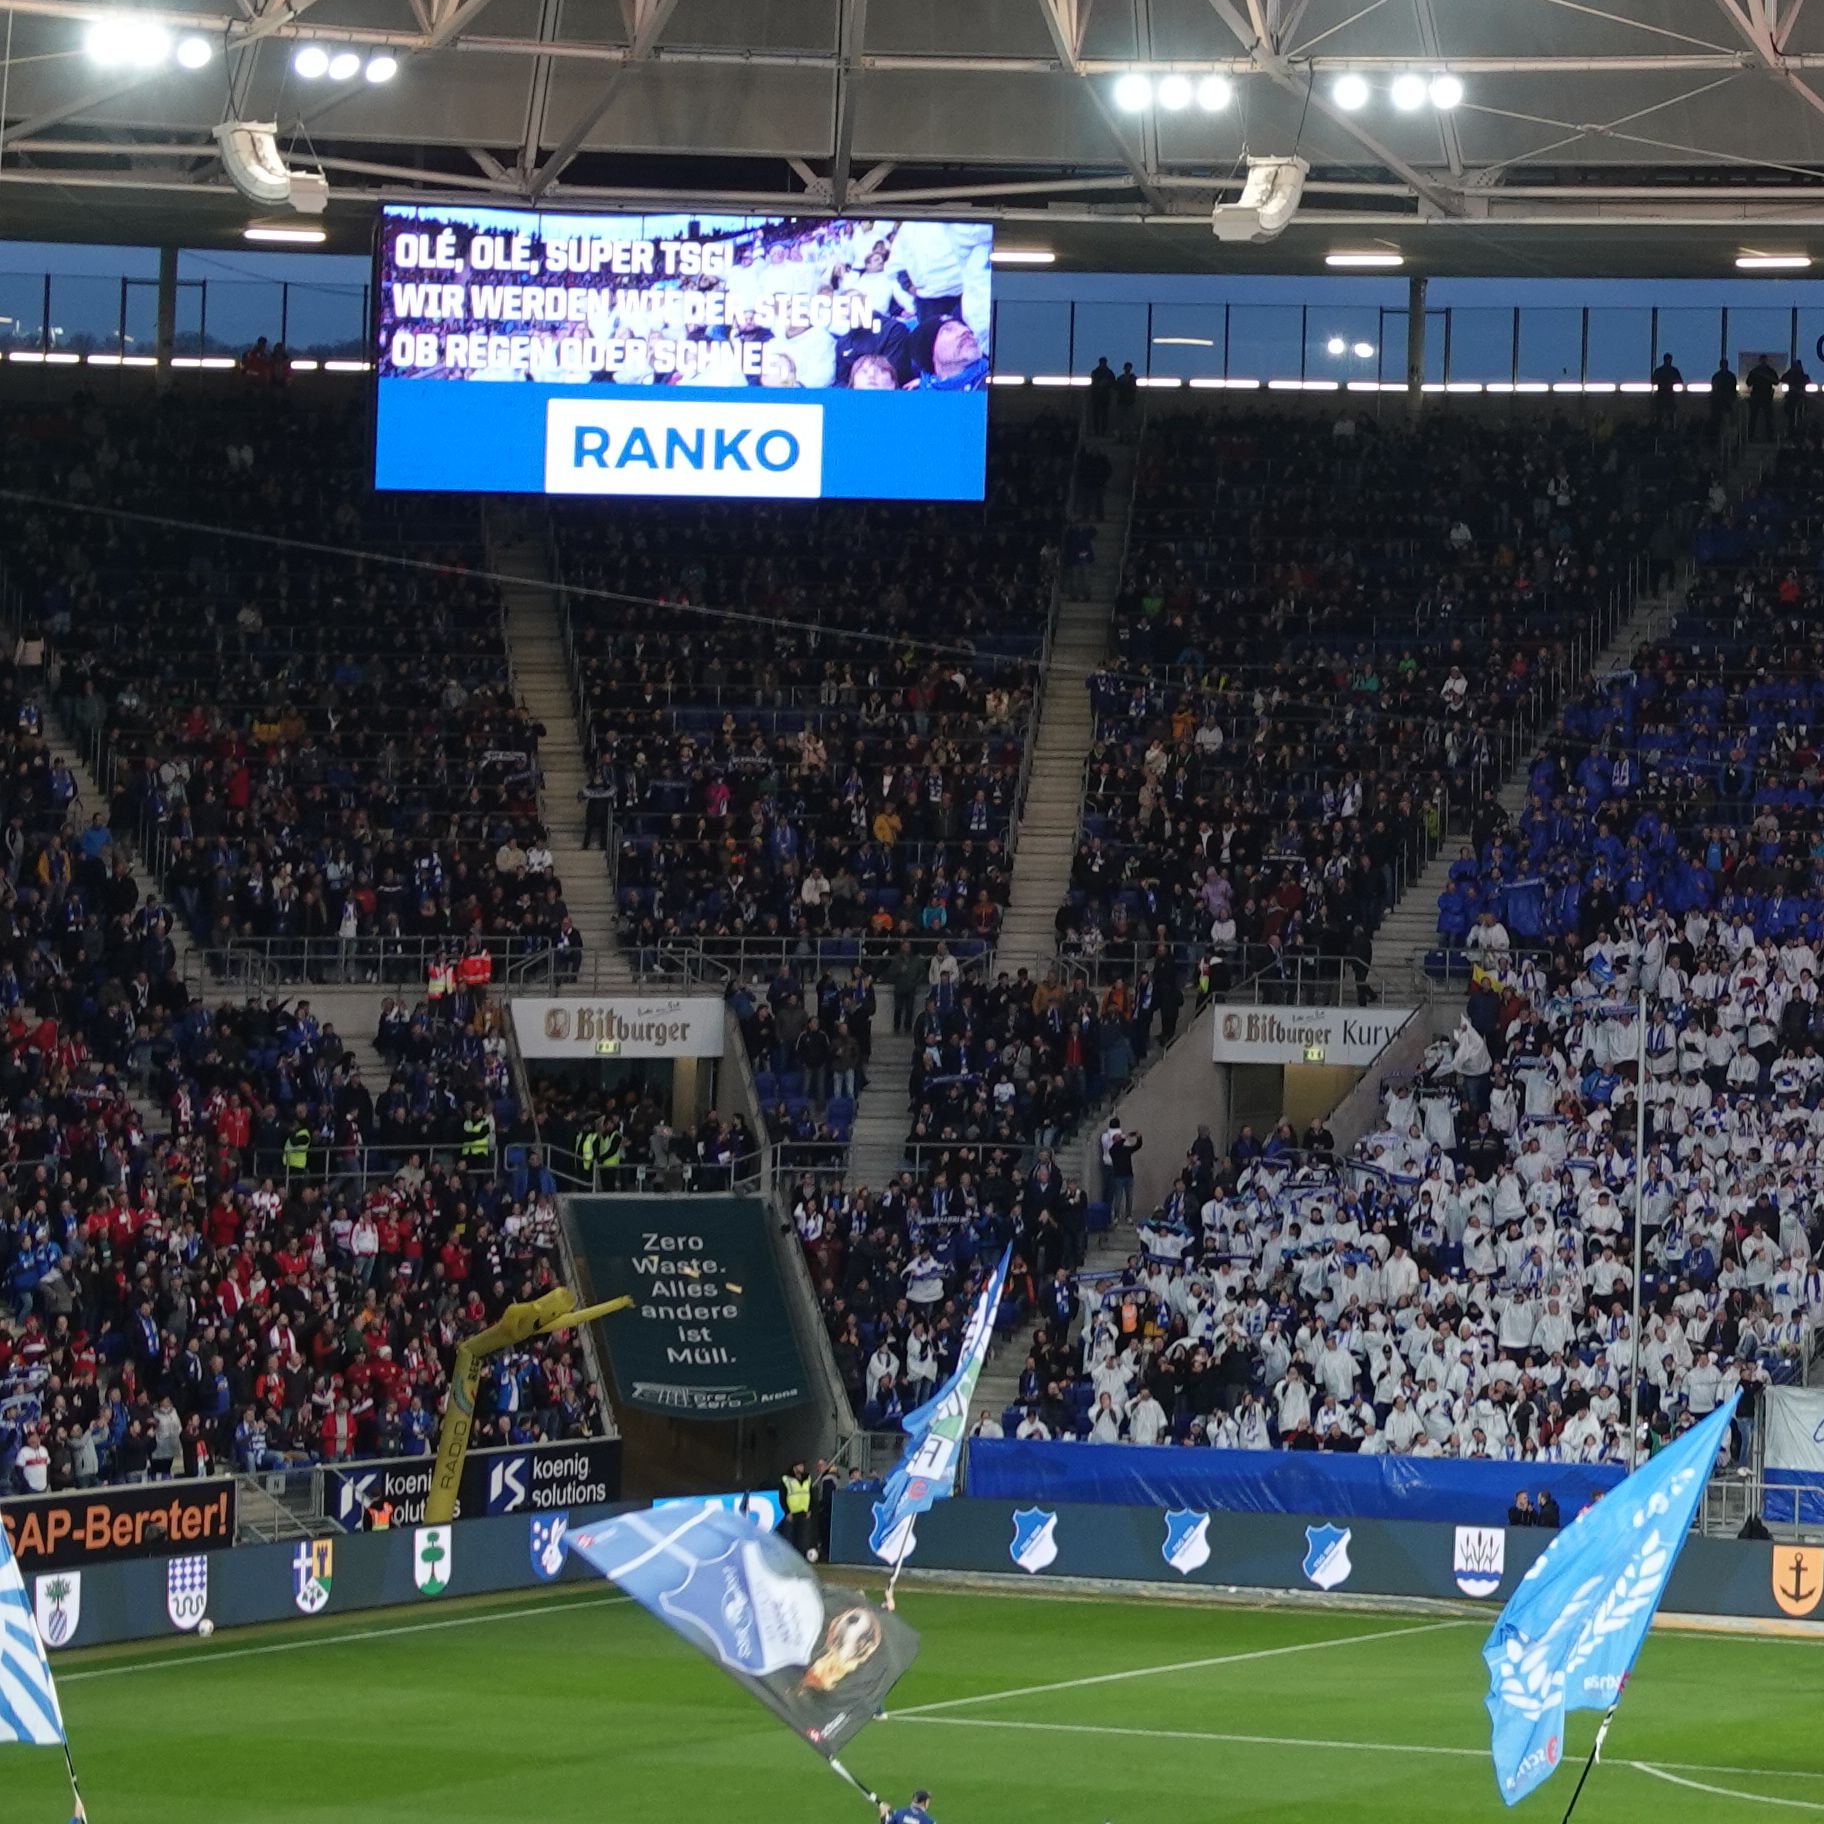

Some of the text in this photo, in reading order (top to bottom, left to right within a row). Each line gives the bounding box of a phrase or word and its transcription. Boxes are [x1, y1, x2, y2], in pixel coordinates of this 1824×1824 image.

[395, 227, 734, 276] OLÉ, OLÉ, SUPER TSG!
[393, 283, 466, 319] WIR
[471, 285, 609, 322] WERDEN
[754, 292, 881, 334] SIEGEN,
[391, 332, 439, 368] OB
[445, 333, 554, 370] REGEN
[558, 335, 650, 373] ODER
[573, 425, 800, 472] RANKO
[575, 1006, 690, 1047] Bitburger
[1244, 1012, 1332, 1048] Bitburger
[642, 1232, 704, 1252] Zero
[632, 1255, 727, 1275] Waste.
[652, 1279, 719, 1298] Alles
[641, 1302, 738, 1321] andere
[667, 1346, 737, 1365] Müll.
[761, 1388, 798, 1403] Arena
[533, 1452, 590, 1481] koenig
[385, 1467, 432, 1496] koeni
[531, 1481, 607, 1509] solutions
